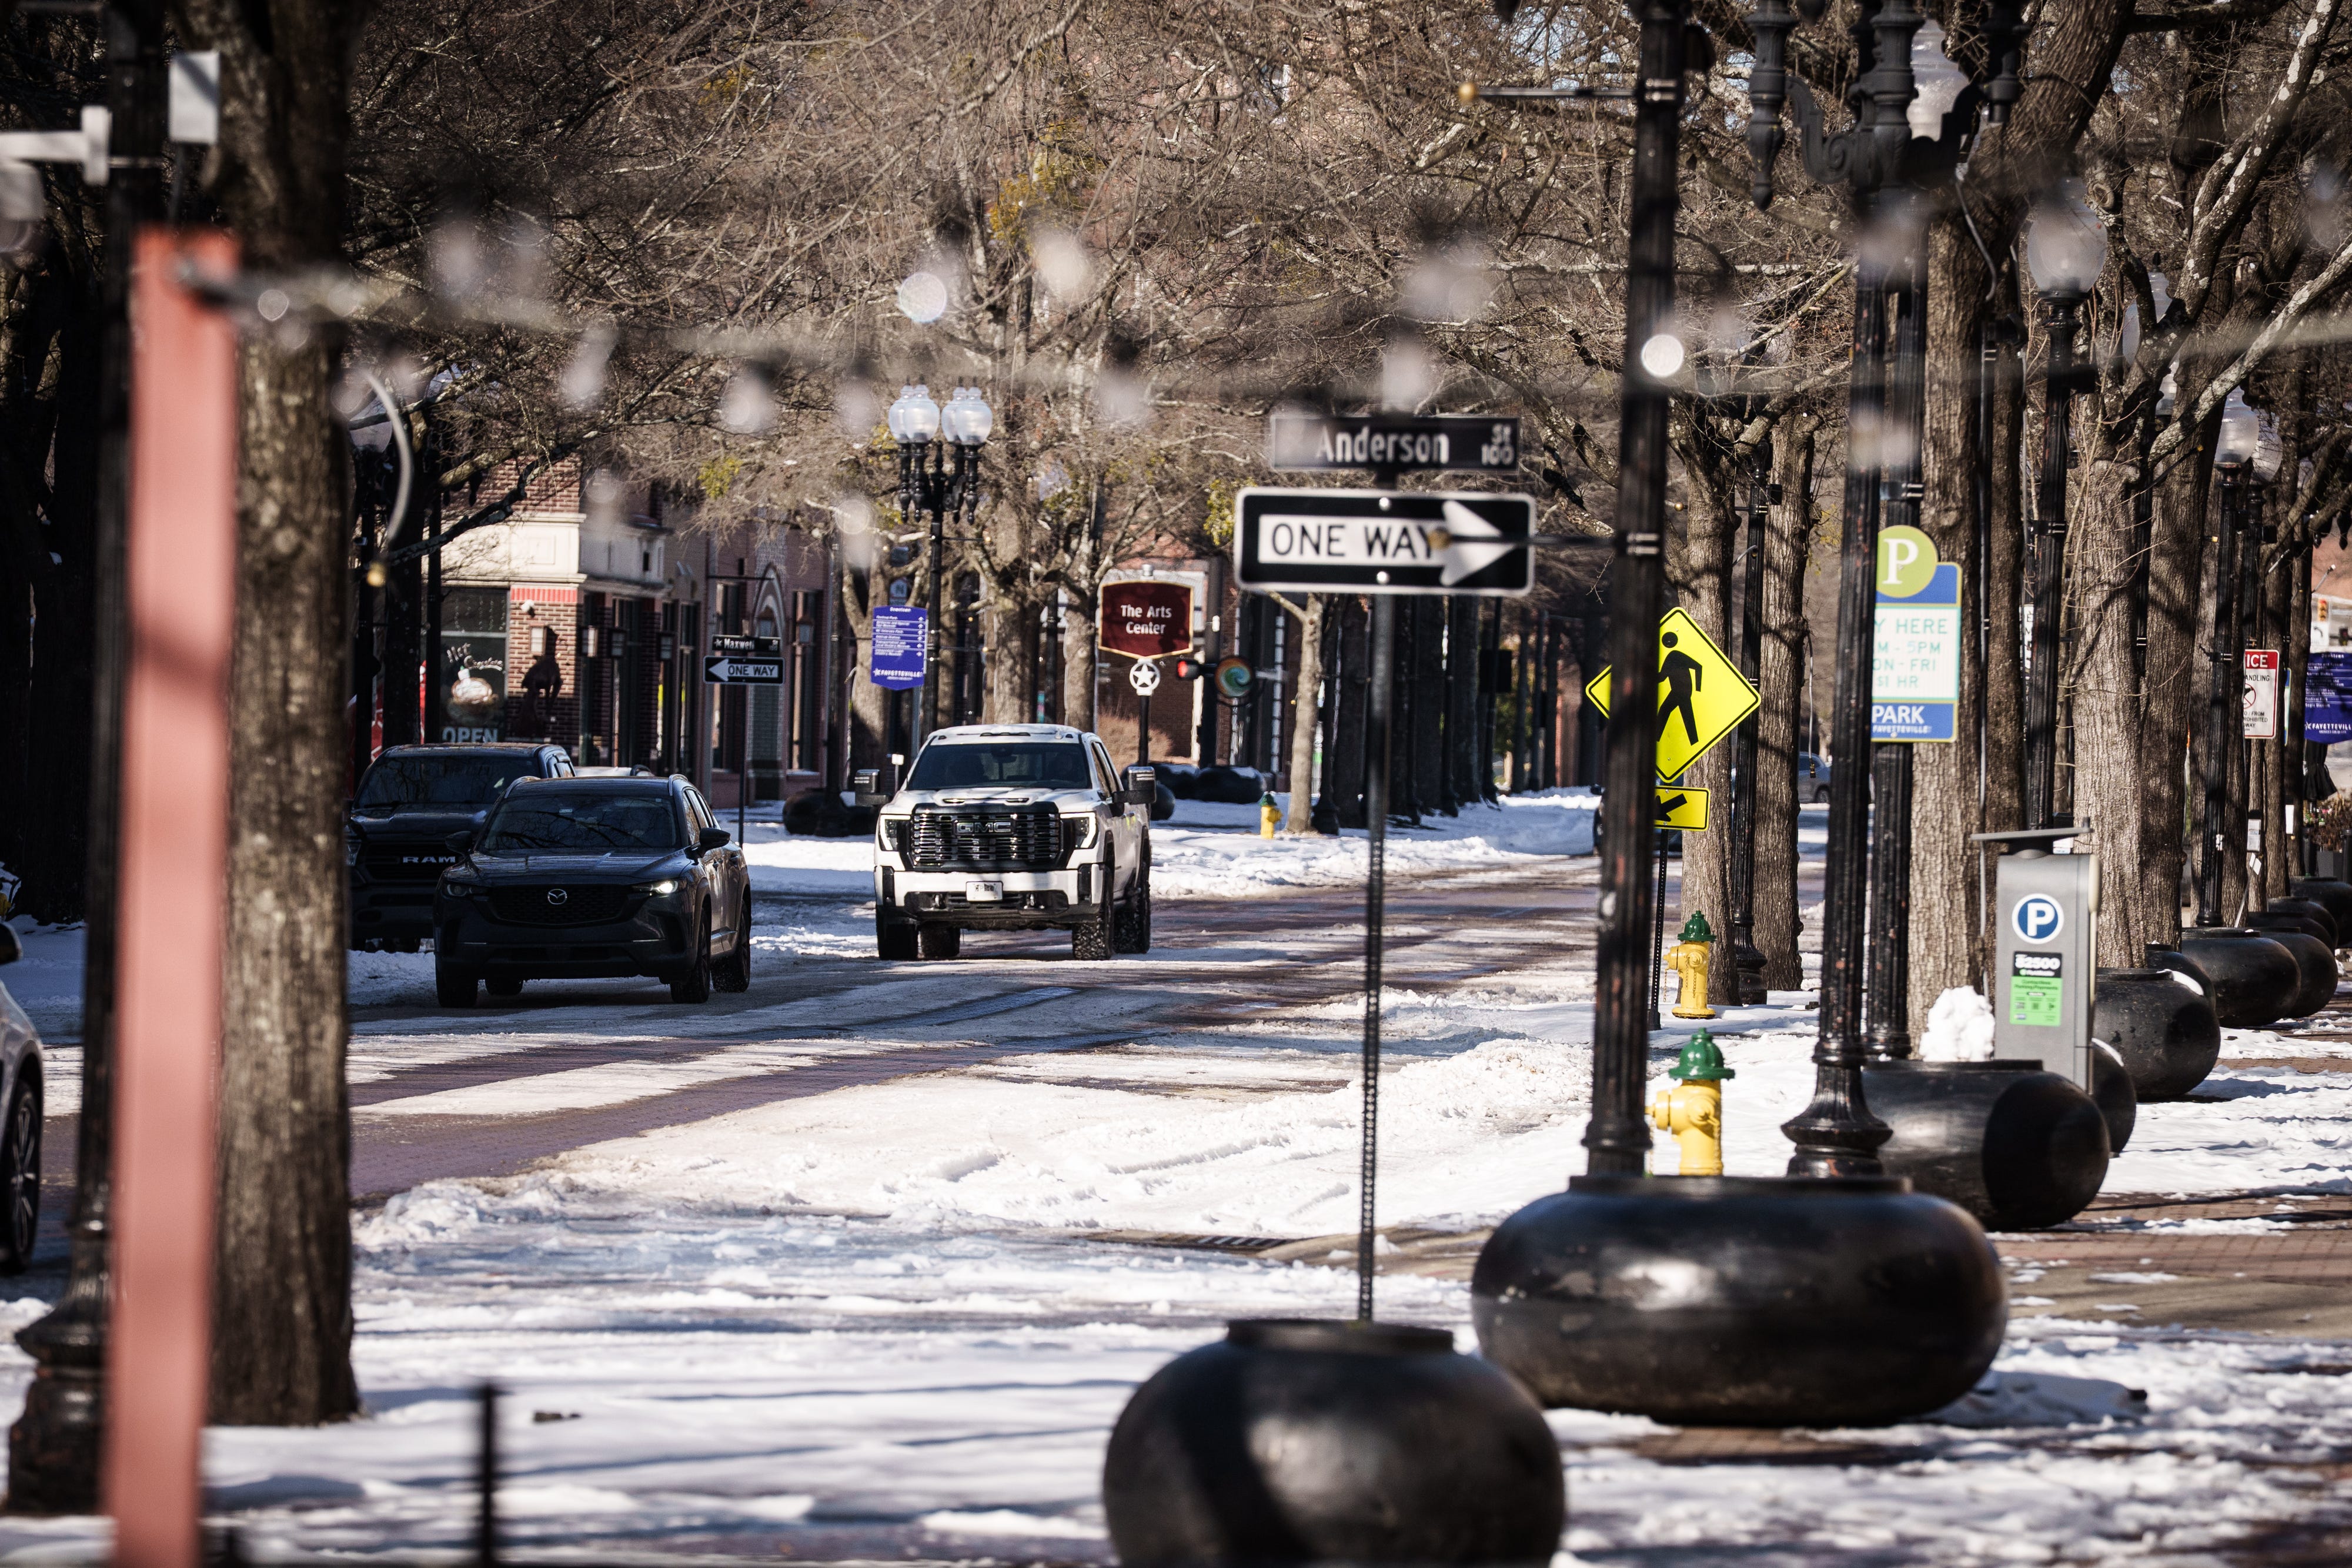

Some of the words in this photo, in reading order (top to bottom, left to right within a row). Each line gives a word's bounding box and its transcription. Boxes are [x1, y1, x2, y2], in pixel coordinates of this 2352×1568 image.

[1315, 424, 1449, 463] Anderson
[1491, 423, 1512, 445] St
[1481, 445, 1514, 466] 100
[1271, 523, 1345, 557] ONE
[1364, 524, 1433, 560] WAY
[1882, 538, 1919, 585] P
[1120, 604, 1142, 618] The
[1146, 606, 1172, 618] Arts
[1125, 621, 1166, 634] Center
[1875, 618, 1886, 634] Y
[1896, 618, 1948, 634] HERE
[724, 638, 755, 650] Maxwell
[1877, 640, 1889, 653] M
[1907, 640, 1940, 654] 5PM
[1873, 658, 1894, 671] ON
[1910, 658, 1936, 671] FRI
[2246, 654, 2268, 668] ICE
[728, 665, 749, 676] ONE
[753, 666, 775, 676] WAY
[1897, 675, 1919, 688] HR
[1872, 705, 1925, 724] PARK
[442, 726, 498, 743] OPEN
[956, 822, 1011, 833] GMC
[2027, 902, 2056, 937] P
